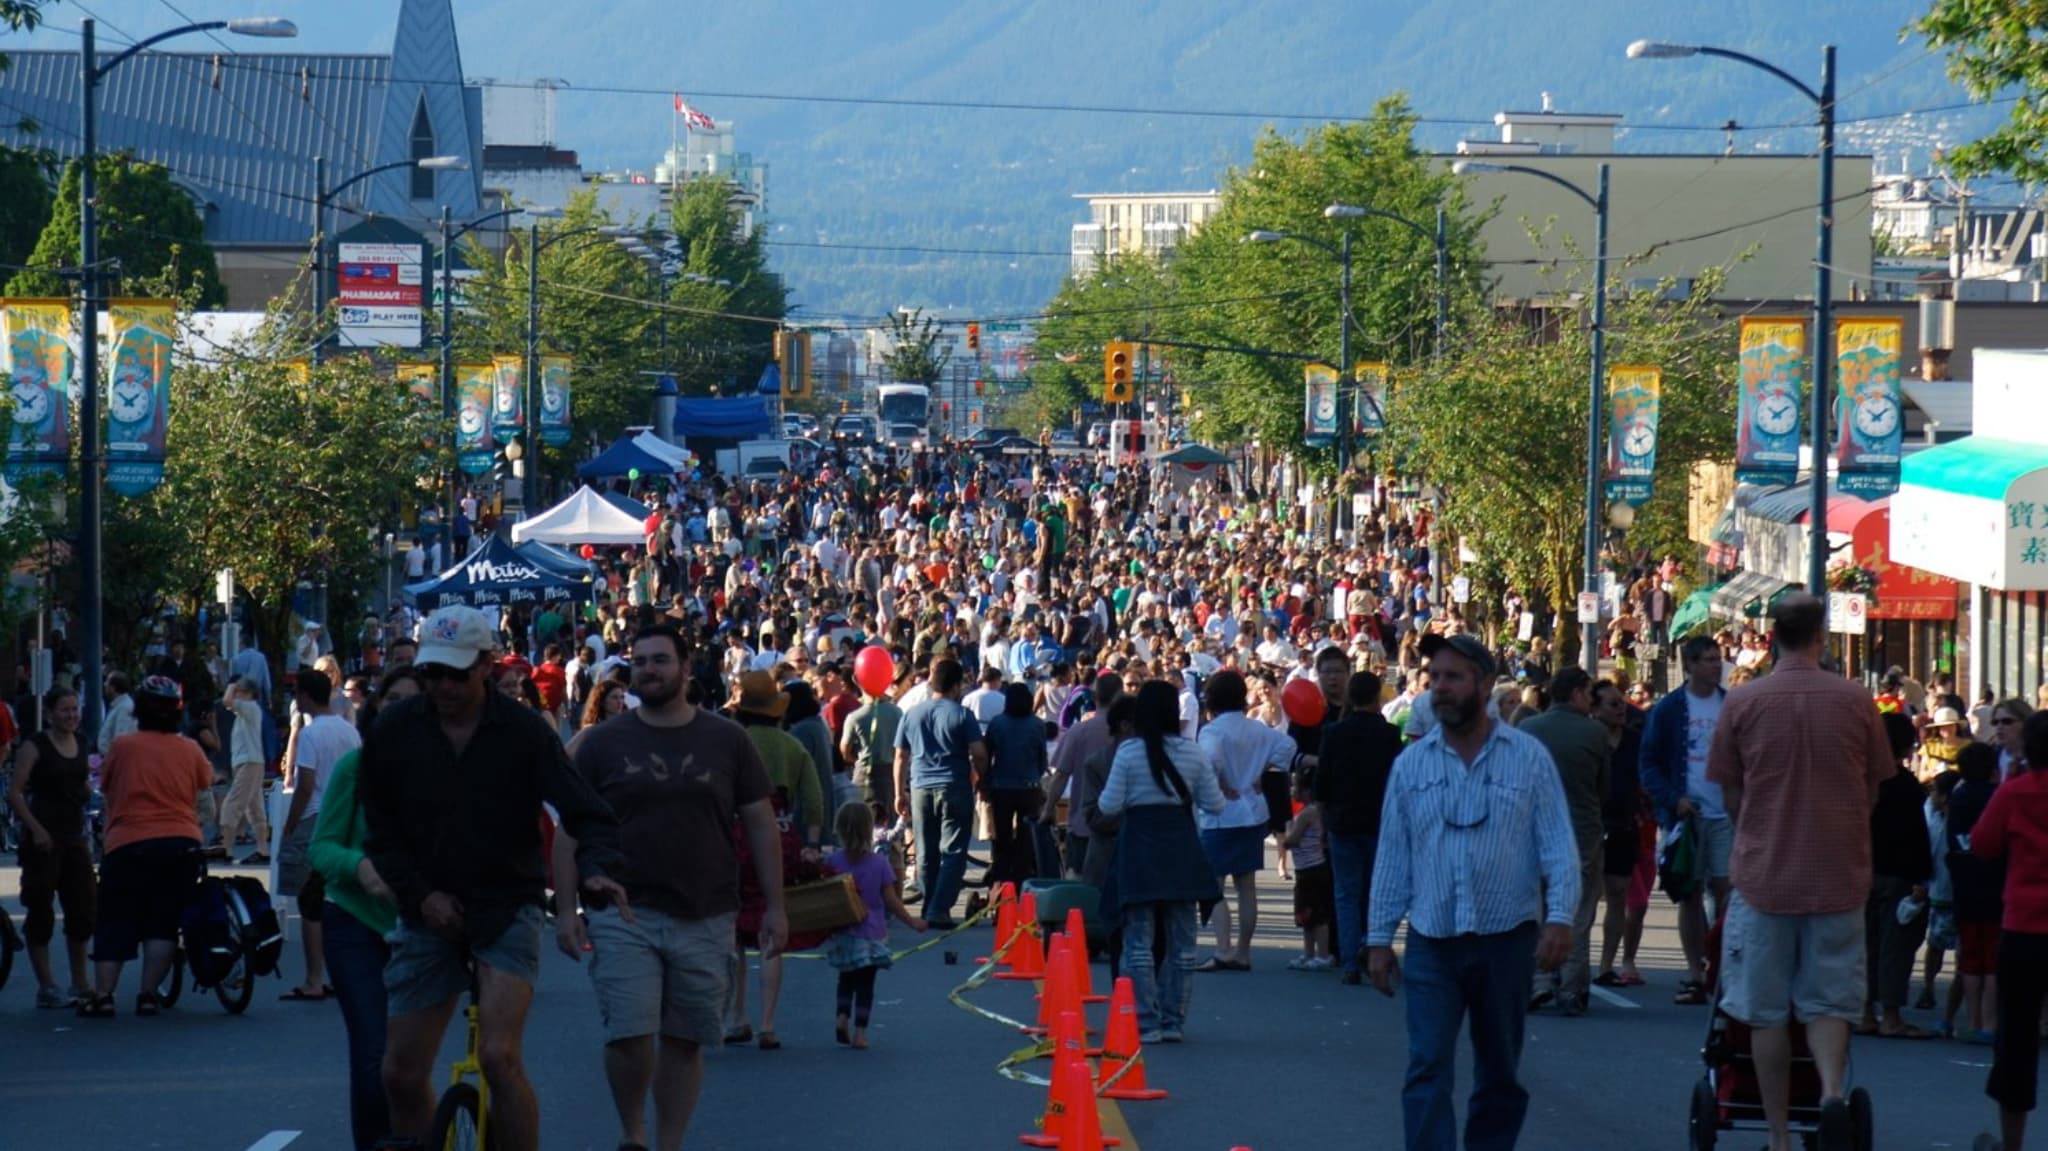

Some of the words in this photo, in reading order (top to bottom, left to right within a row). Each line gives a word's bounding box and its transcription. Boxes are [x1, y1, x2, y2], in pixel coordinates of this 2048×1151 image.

[373, 313, 394, 321] PLAY
[396, 313, 419, 321] HERE
[466, 560, 541, 584] Matix
